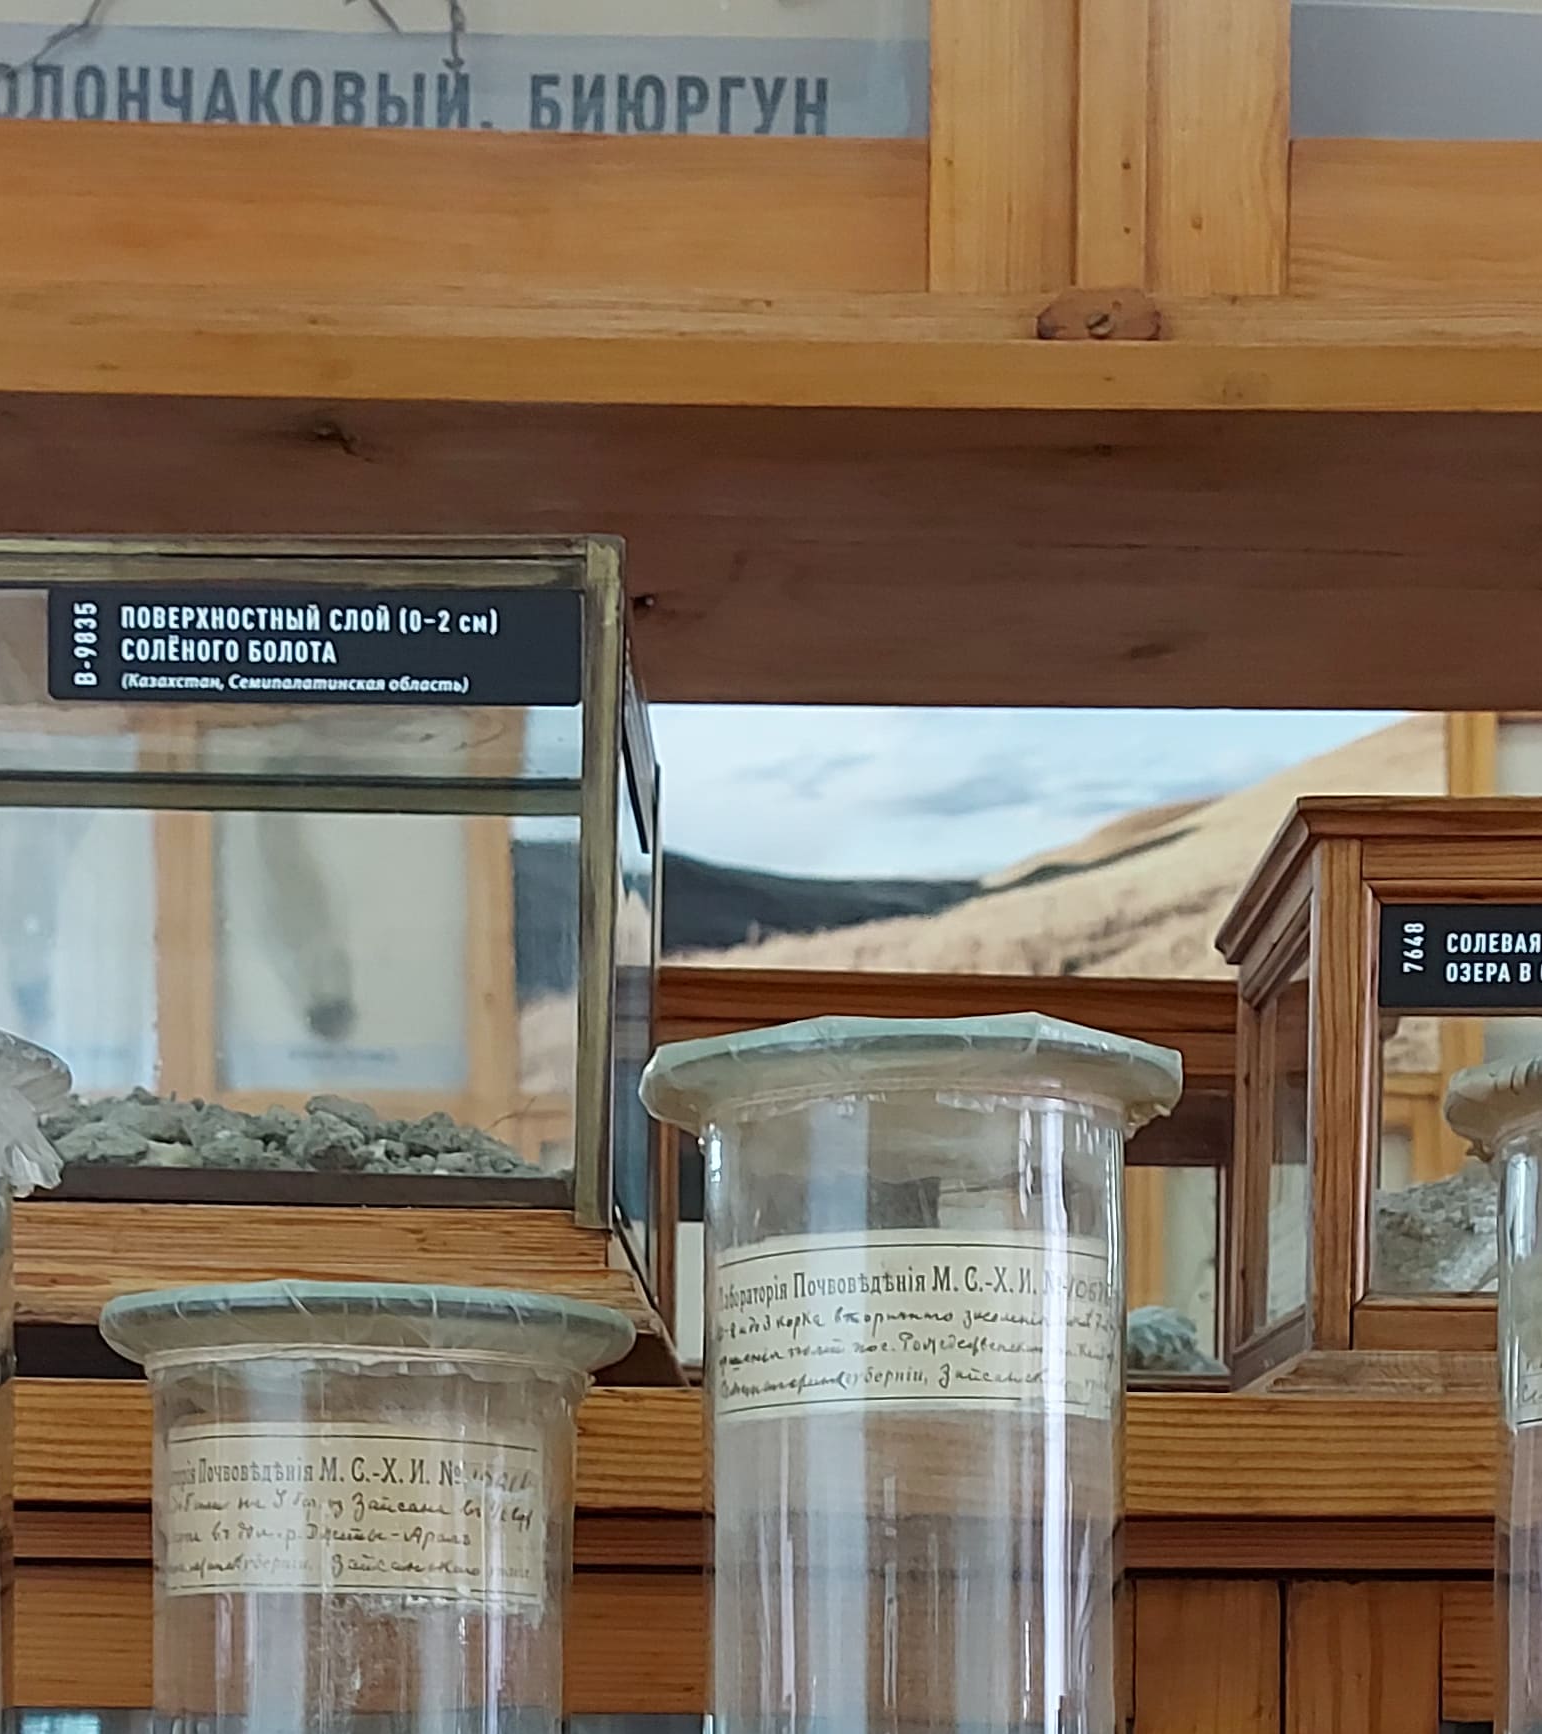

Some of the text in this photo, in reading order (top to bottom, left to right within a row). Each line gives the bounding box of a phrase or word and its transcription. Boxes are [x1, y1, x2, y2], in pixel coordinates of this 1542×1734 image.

[529, 74, 829, 135] БИЮРГУН
[122, 605, 320, 630] ПОВЕРХНОСТНЫЙ
[330, 605, 390, 631] СЛОЙ
[459, 609, 497, 634] см)
[74, 603, 97, 685] В-9835
[122, 635, 336, 663] СОЛЁНОГО БОЛОТА
[122, 673, 468, 693] (Казахстан, Семипалатинская область)
[1403, 923, 1424, 972] 7648
[1447, 933, 1541, 953] СОЛЕВАЯ
[1446, 963, 1510, 982] ОЗЕРА
[1520, 963, 1531, 982] В
[932, 1265, 959, 1292] М.
[1019, 1267, 1037, 1295] И.
[319, 1455, 345, 1482] М.
[409, 1458, 431, 1485] И.
